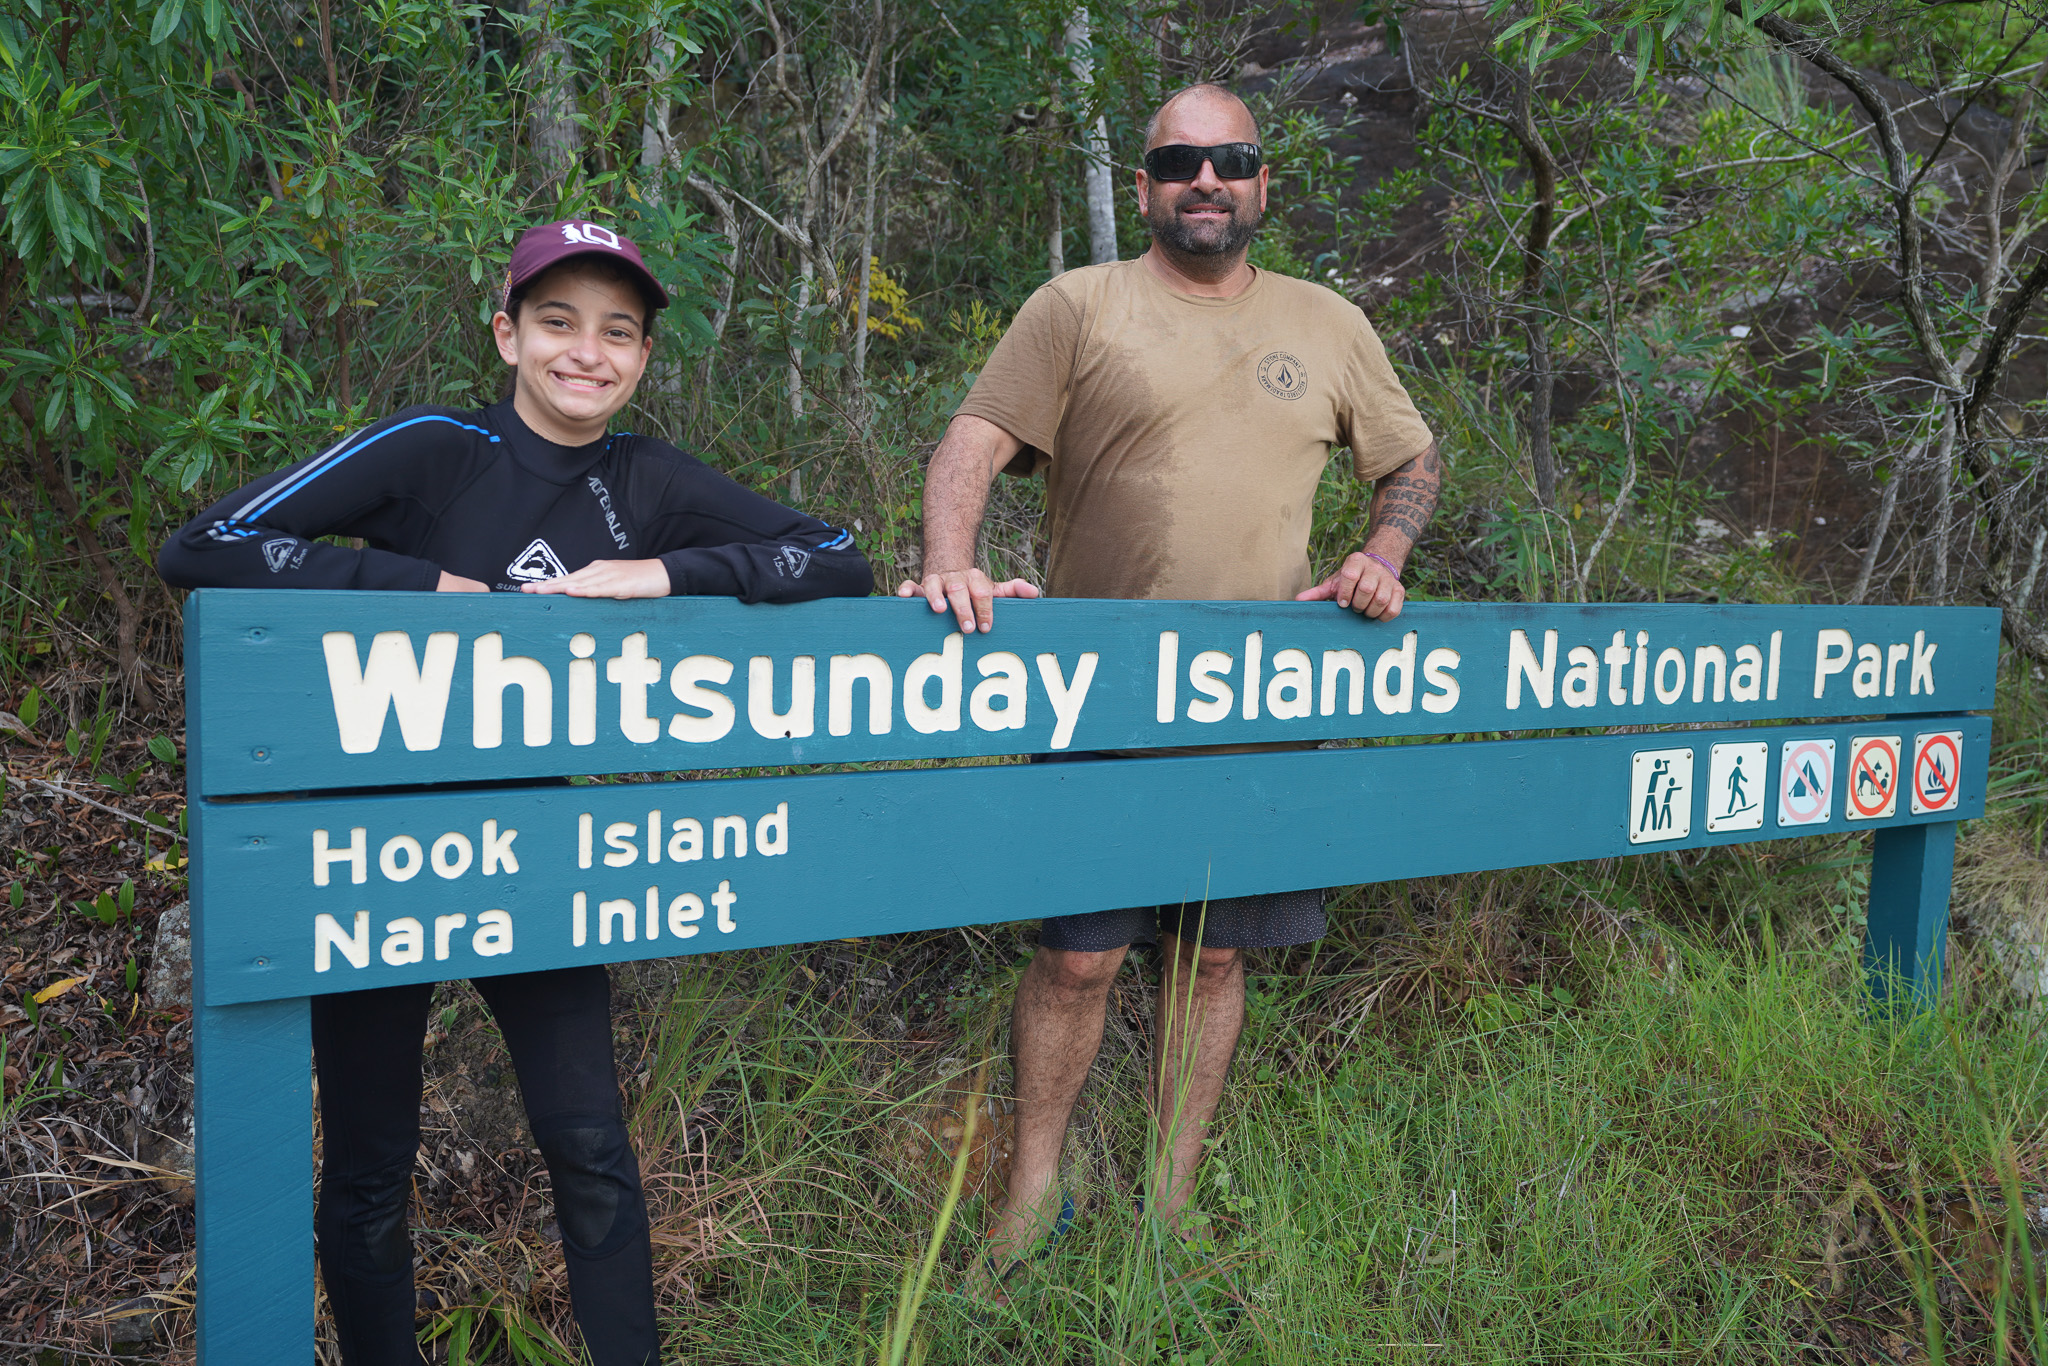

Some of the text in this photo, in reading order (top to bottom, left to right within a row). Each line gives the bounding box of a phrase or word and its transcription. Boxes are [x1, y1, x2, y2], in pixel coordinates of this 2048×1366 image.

[1279, 353, 1302, 369] COMPANY
[588, 475, 630, 551] ADRENALIN
[321, 628, 1938, 755] Whitsunday Islands National Park
[312, 802, 789, 887] Hook Island
[314, 879, 738, 974] Nara Inlet
